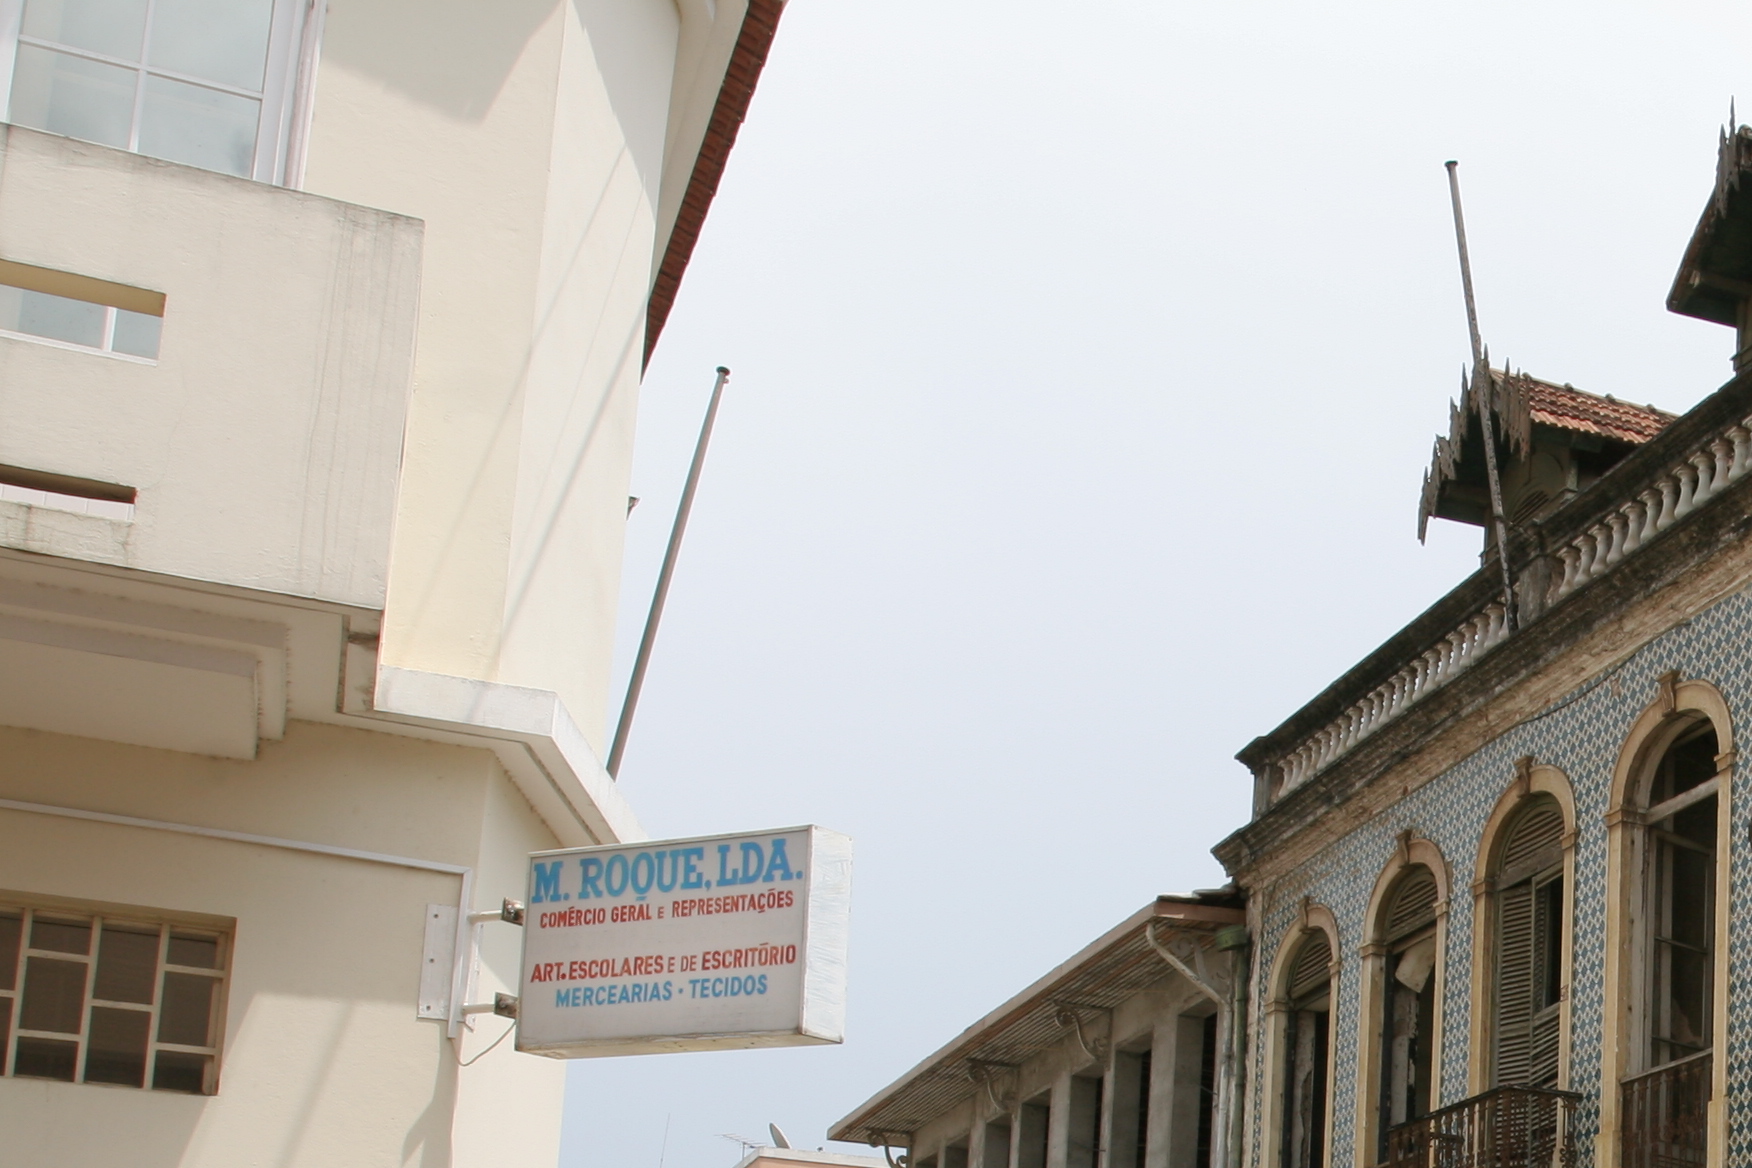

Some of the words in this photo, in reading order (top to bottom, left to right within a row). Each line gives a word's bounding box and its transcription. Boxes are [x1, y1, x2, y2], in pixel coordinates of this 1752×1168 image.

[531, 860, 571, 904] M.
[716, 838, 804, 887] LDA.
[539, 906, 607, 929] COMÉRCIO
[611, 903, 653, 923] GERAL
[657, 906, 665, 919] E
[671, 888, 795, 918] REPRESENTAÇÕES
[667, 956, 676, 973] E
[680, 955, 697, 972] DE
[701, 942, 797, 971] ESCRITÓRIO
[555, 980, 673, 1008] MERCEARIAS
[688, 974, 768, 999] TECIDOS
